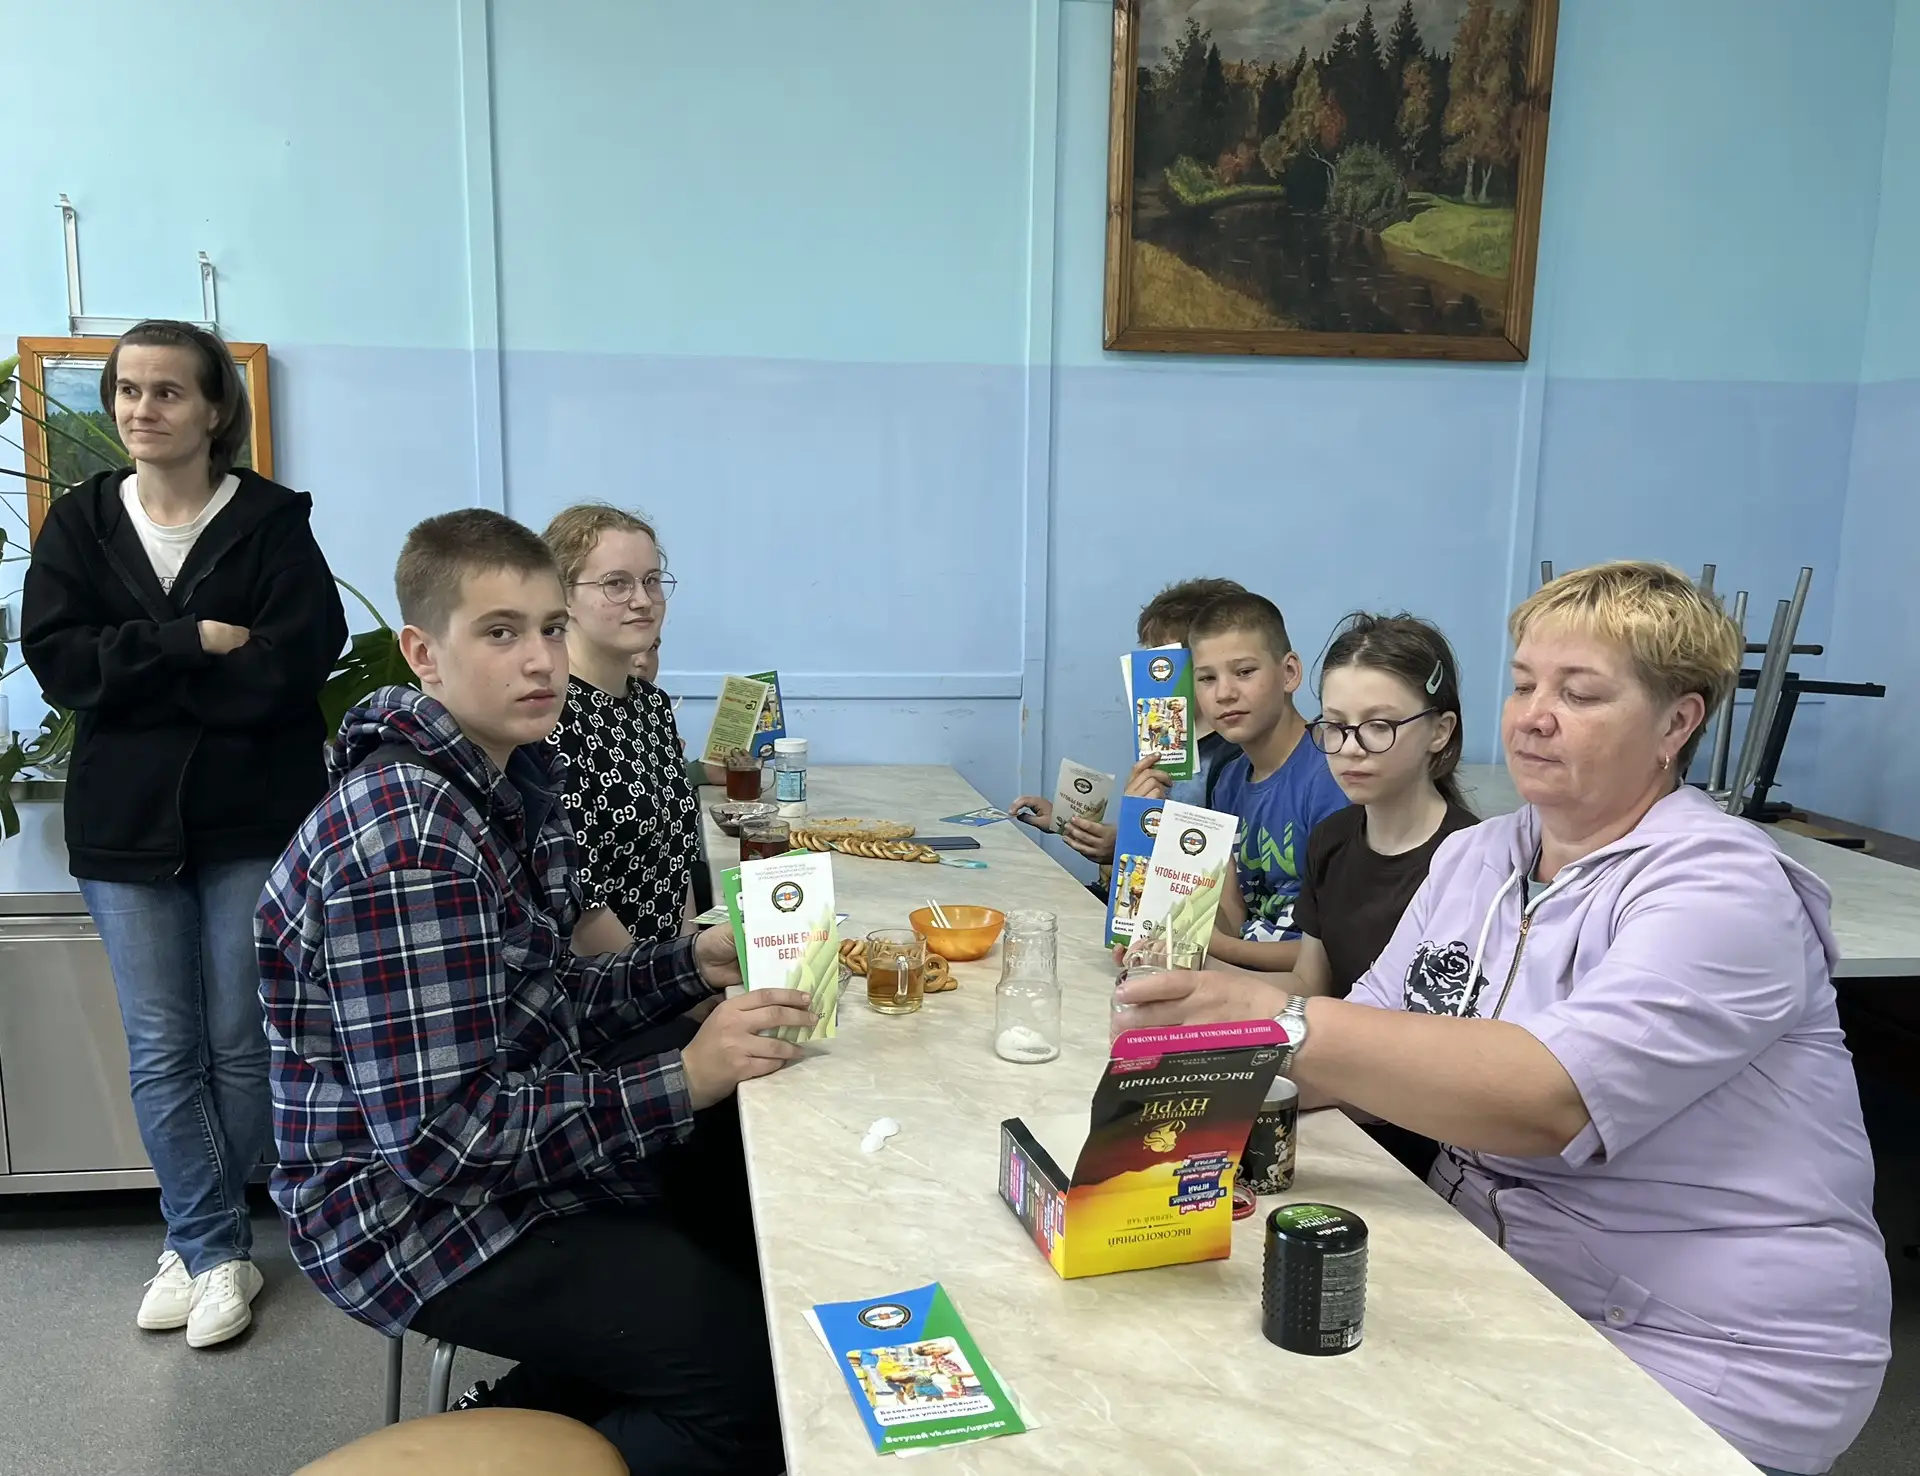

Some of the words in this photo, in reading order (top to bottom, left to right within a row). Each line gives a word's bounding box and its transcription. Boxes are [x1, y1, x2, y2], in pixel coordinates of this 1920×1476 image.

[1154, 866, 1180, 880] ЧТОБЫ
[1181, 872, 1192, 883] НЕ
[1192, 875, 1216, 889] БЫЛО
[1170, 882, 1194, 896] БЕДЫ
[754, 934, 785, 948] ЧТОБЫ
[788, 932, 799, 944] НЕ
[1126, 1036, 1168, 1044] УПАКОВКИ
[1200, 1028, 1242, 1038] ПРОМОКОД
[1118, 1071, 1255, 1090] ВЫСОКОГОРНЫЙ
[1141, 1098, 1210, 1116] НУРИ
[1188, 1183, 1210, 1194] ИГРАЙ
[1127, 1218, 1142, 1226] ЧАЙ
[1108, 1228, 1192, 1248] ВЫСОКОГОРНЫЙ
[1316, 1226, 1348, 1236] Jardin
